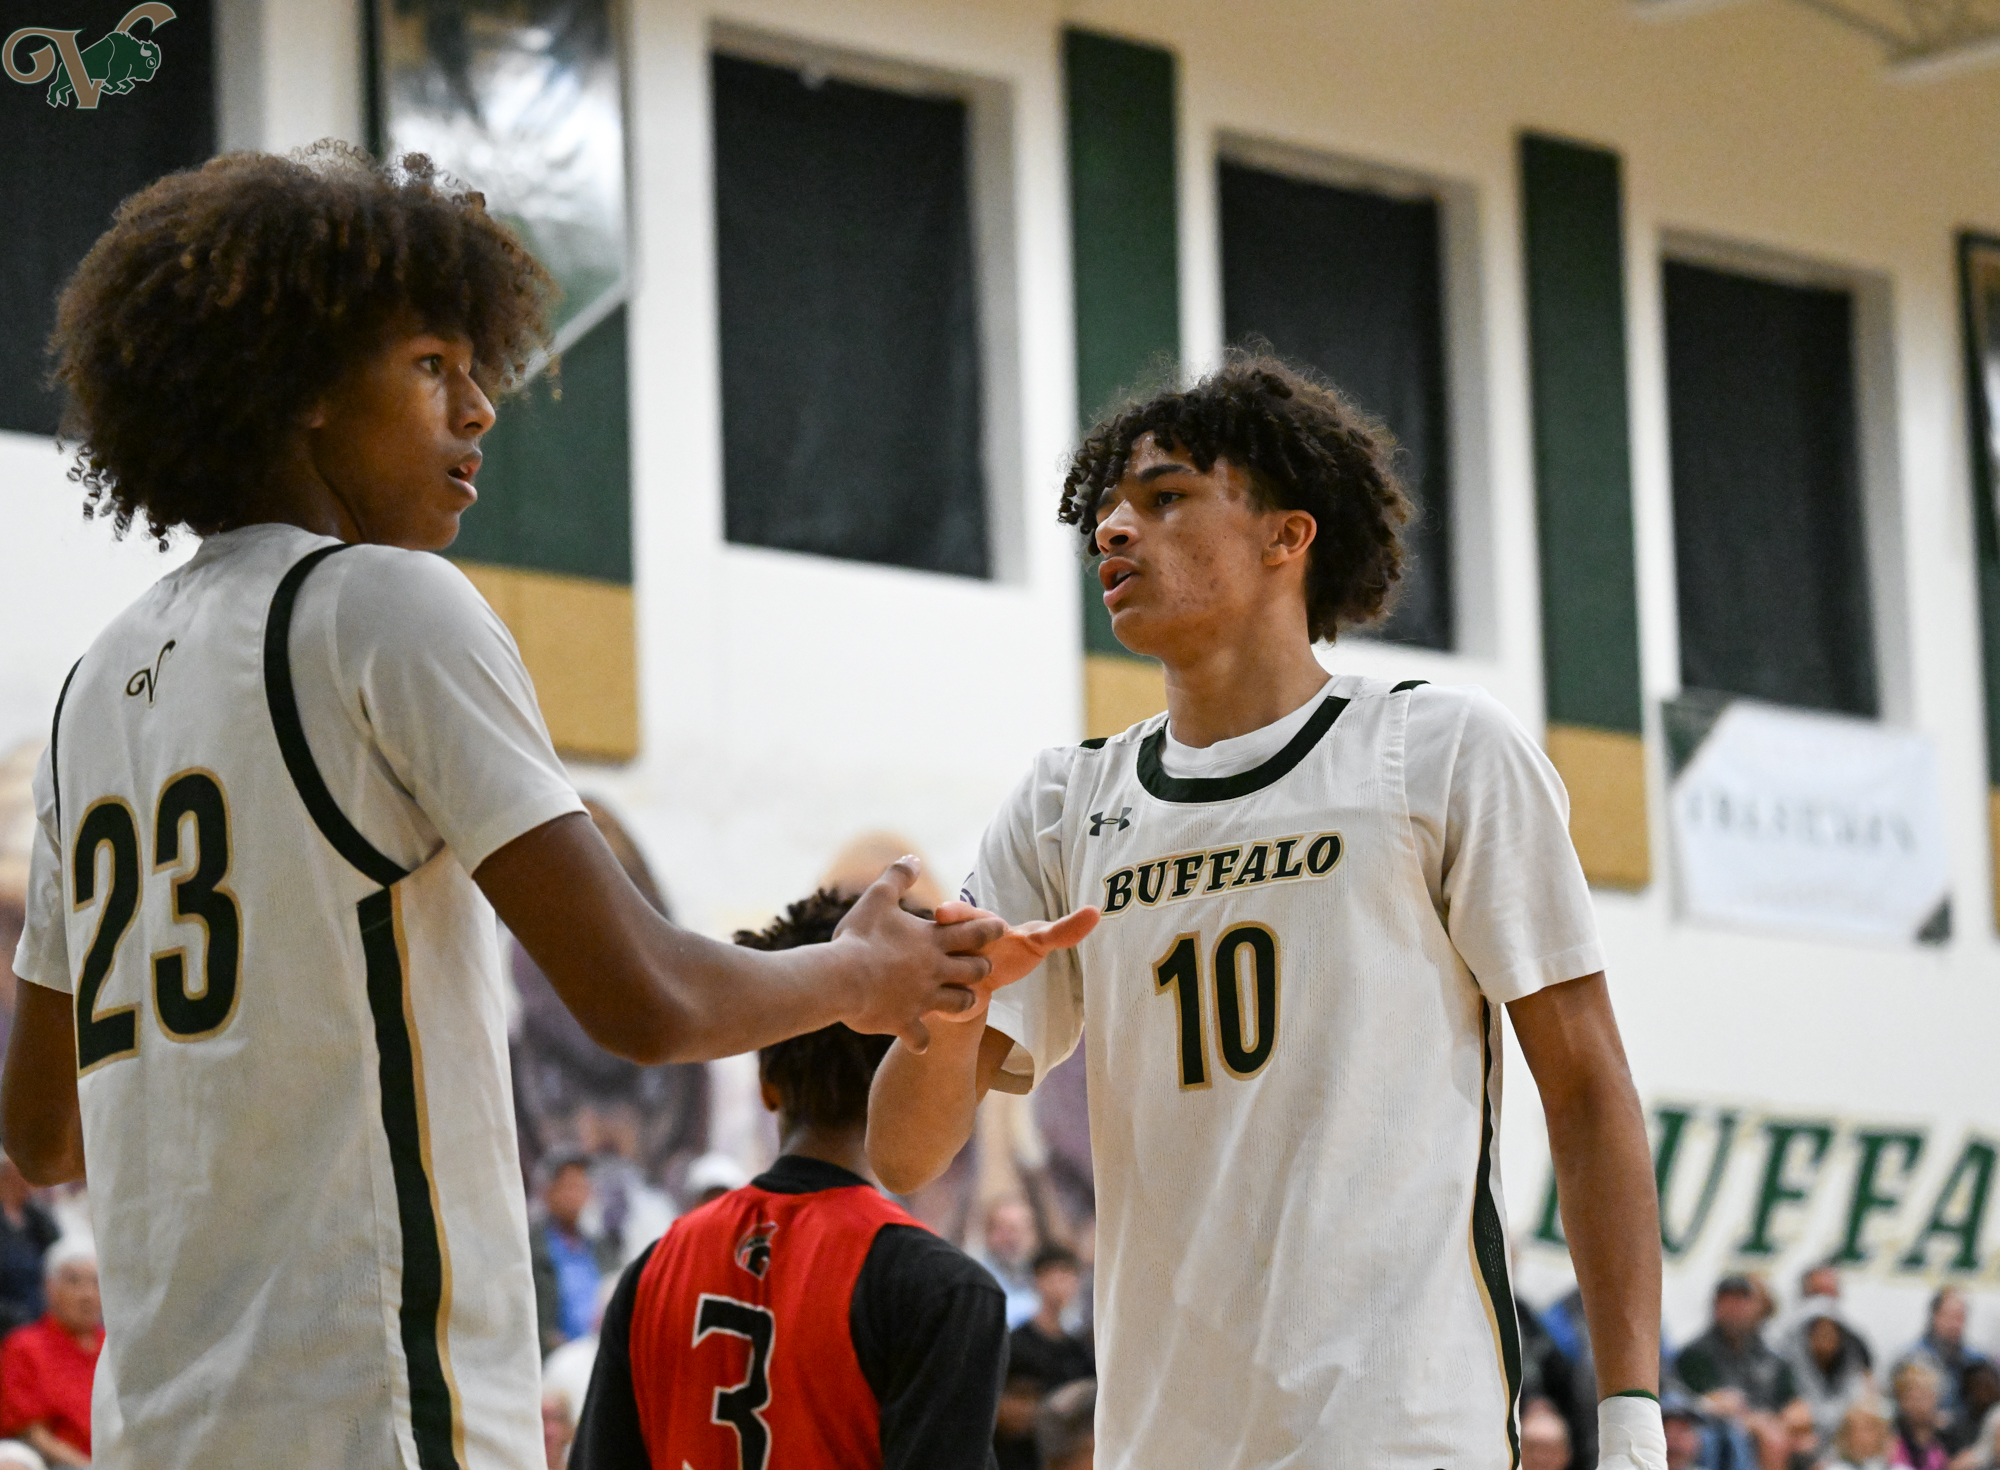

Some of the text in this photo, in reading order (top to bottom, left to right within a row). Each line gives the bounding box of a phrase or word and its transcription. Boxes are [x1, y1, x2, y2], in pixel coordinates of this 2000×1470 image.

[72, 766, 243, 1078] 23
[1101, 832, 1344, 917] BUFFALO
[1152, 920, 1281, 1093] 10
[682, 1293, 776, 1470] 3
